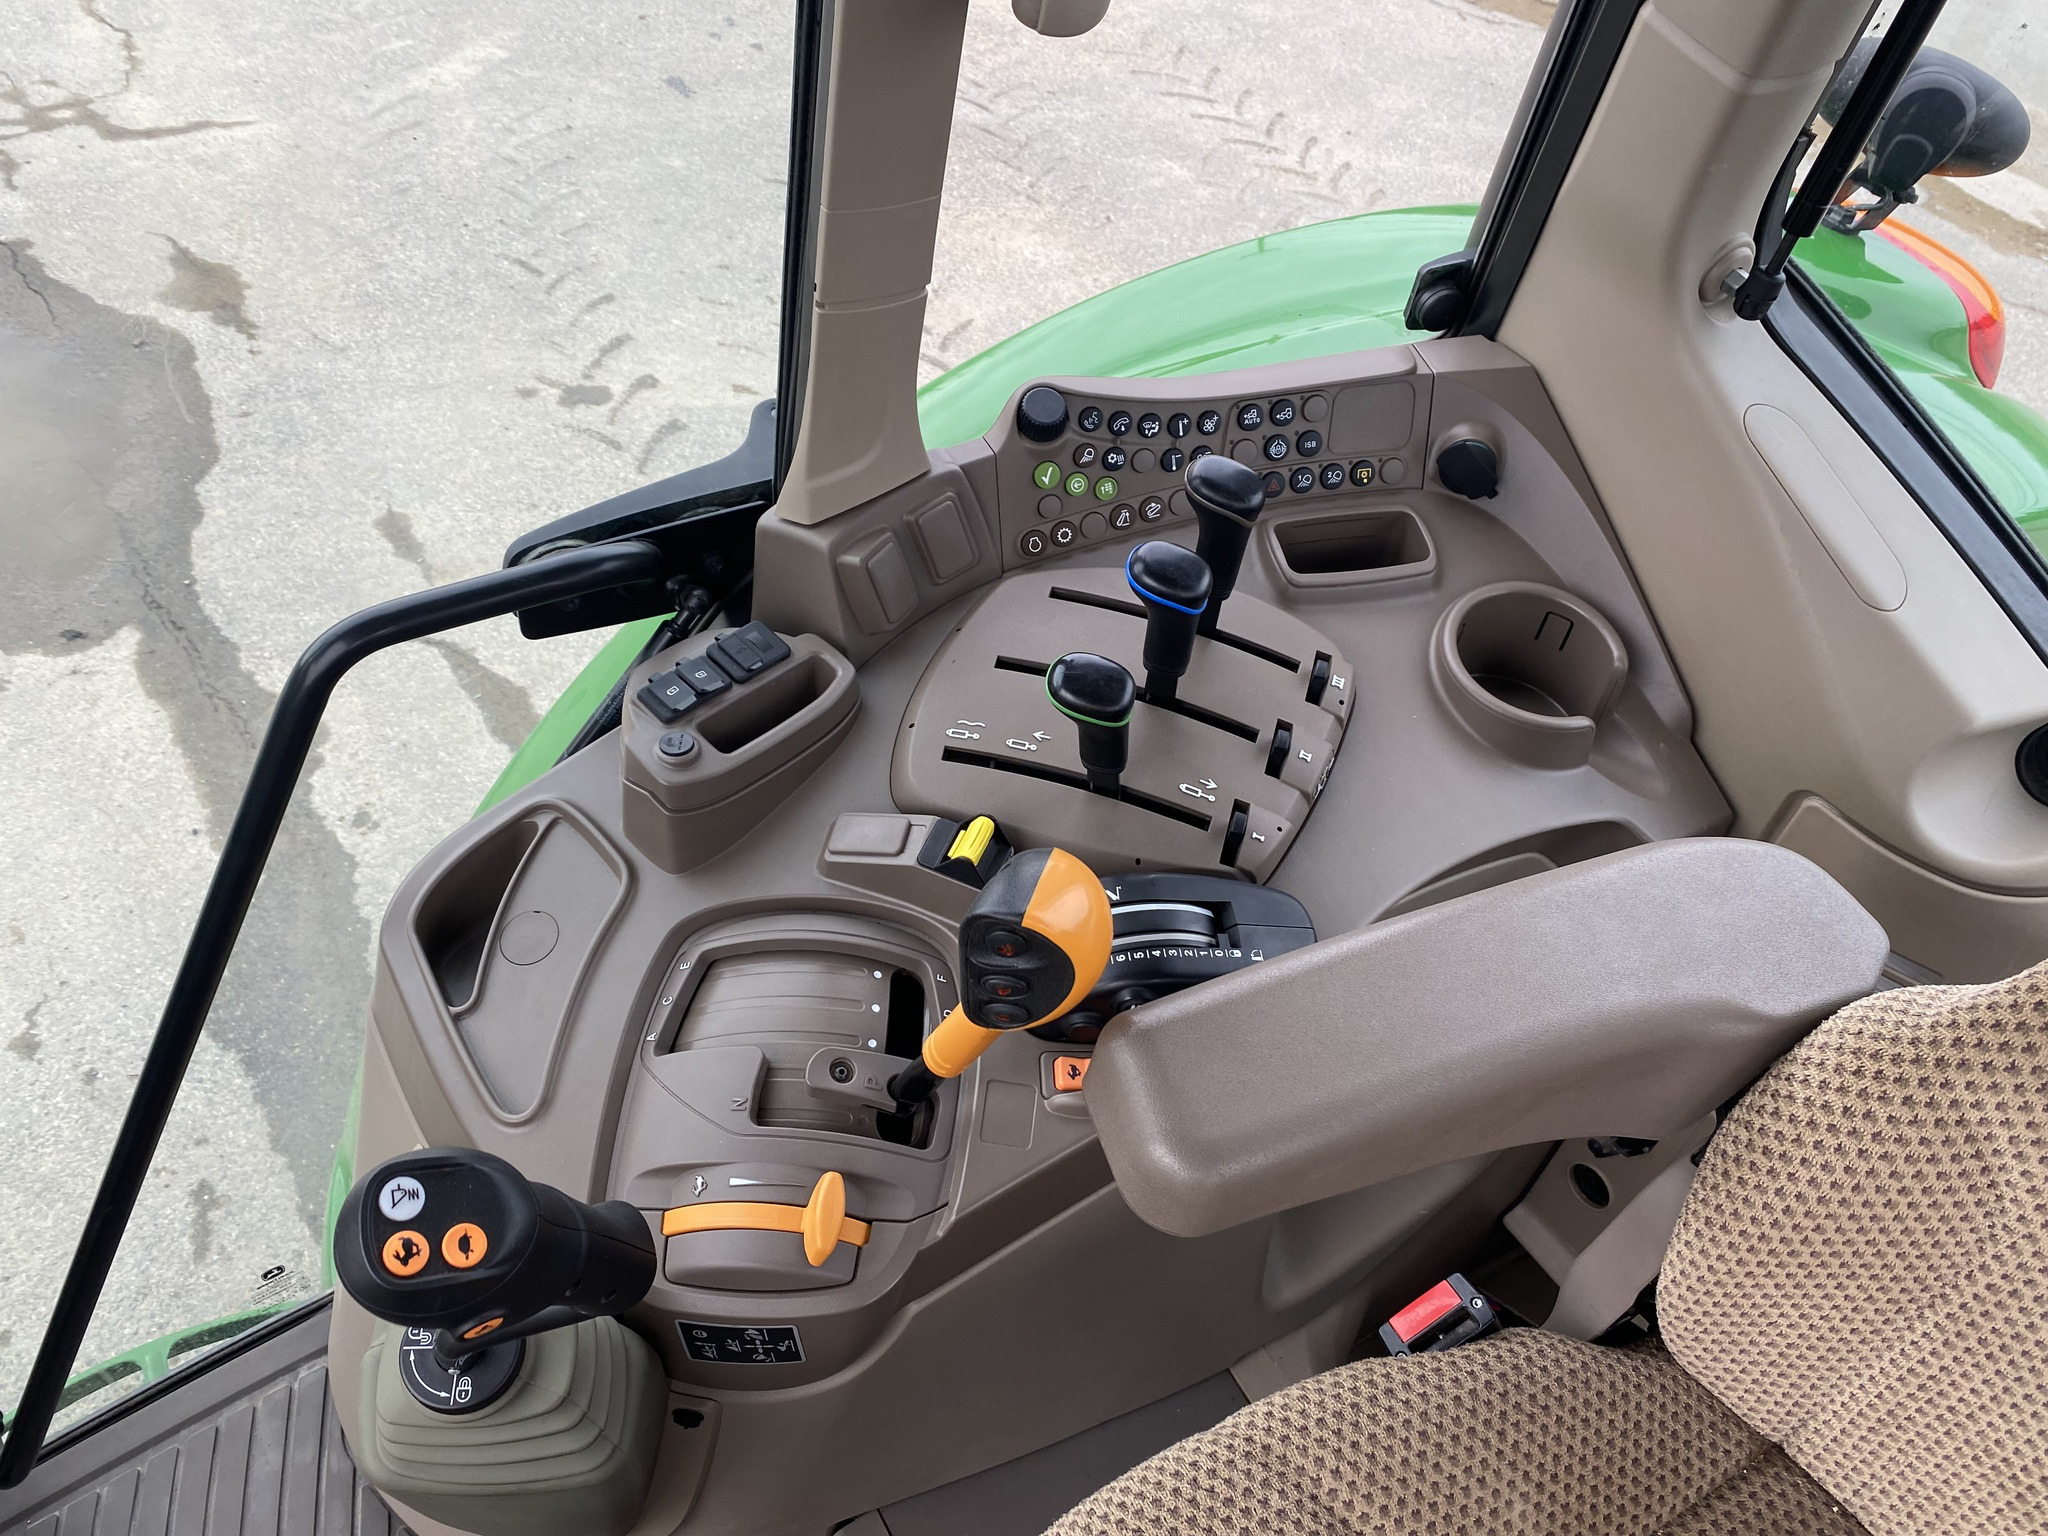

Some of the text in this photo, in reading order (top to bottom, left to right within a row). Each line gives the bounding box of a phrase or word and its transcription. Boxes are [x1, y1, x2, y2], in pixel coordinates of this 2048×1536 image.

[1243, 417, 1261, 425] AUTO
[1304, 440, 1317, 449] ISB
[1331, 674, 1346, 690] III
[1298, 749, 1313, 763] II
[1115, 954, 1126, 962] 6
[1133, 951, 1145, 959] 5
[1168, 949, 1179, 957] 3
[1184, 949, 1194, 957] 2
[1214, 949, 1224, 957] 0
[680, 961, 691, 970] E
[936, 973, 947, 983] F
[662, 995, 673, 1005] C
[646, 1032, 657, 1041] A
[730, 1097, 749, 1112] N
